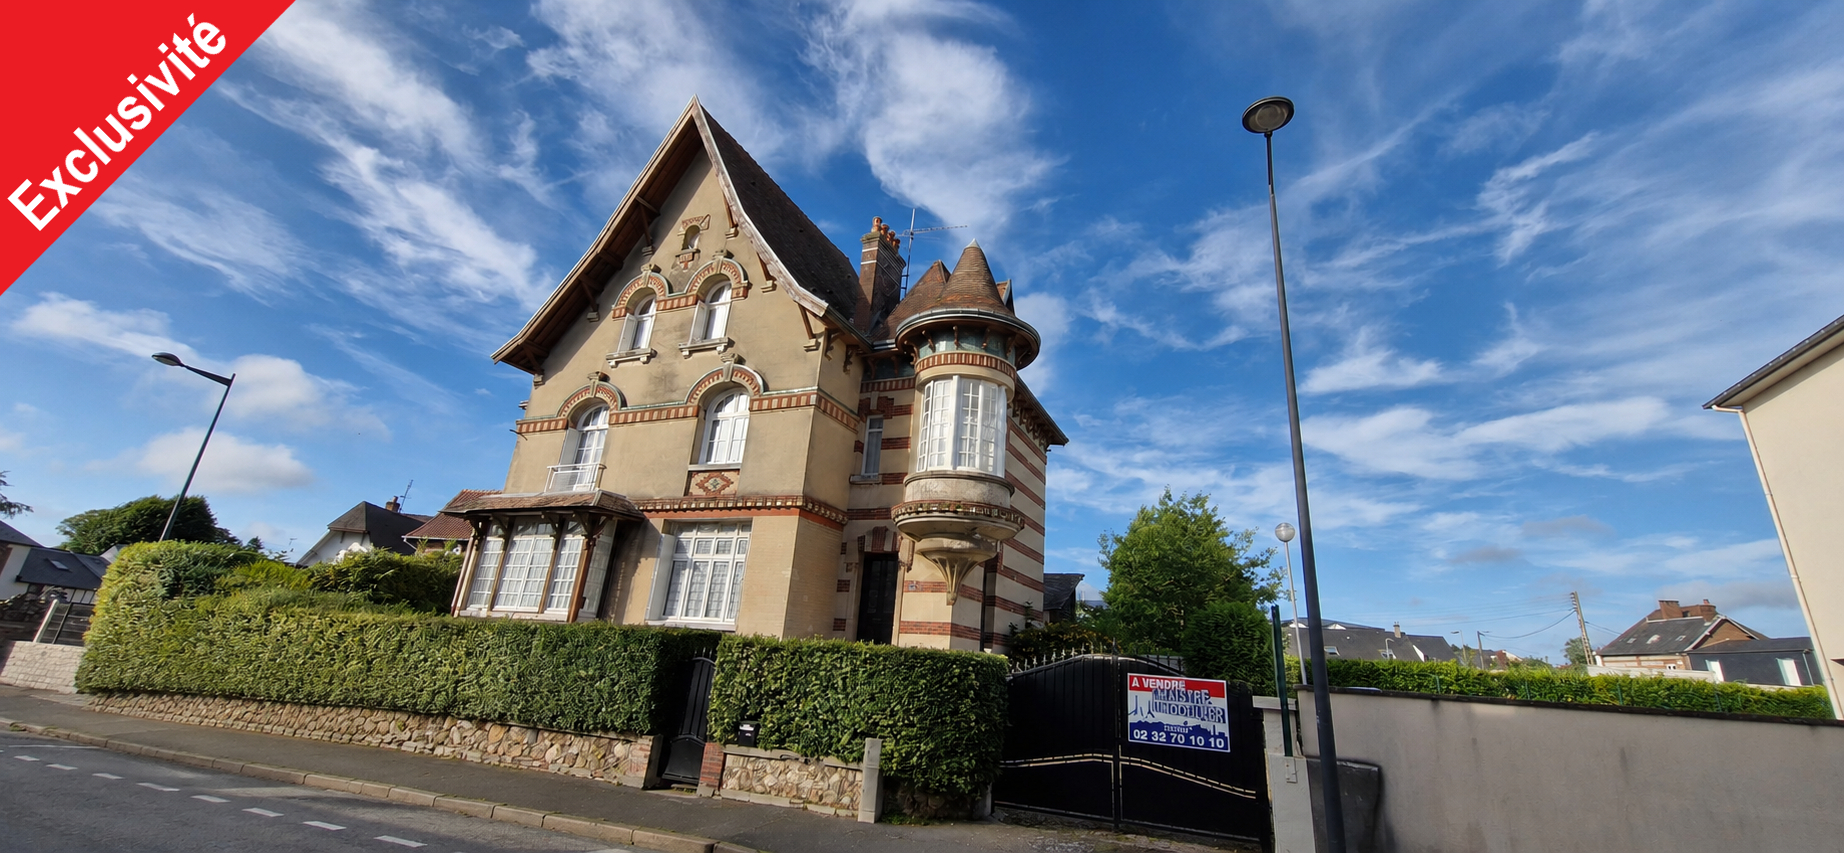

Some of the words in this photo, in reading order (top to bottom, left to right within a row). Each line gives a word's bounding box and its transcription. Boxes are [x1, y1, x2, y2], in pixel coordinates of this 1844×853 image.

[1131, 677, 1140, 688] A
[1142, 677, 1186, 690] VENDRE
[1133, 729, 1148, 740] 02
[1151, 731, 1166, 742] 32
[1170, 733, 1185, 744] 70
[1189, 735, 1205, 746] 10
[1209, 737, 1224, 748] 10
